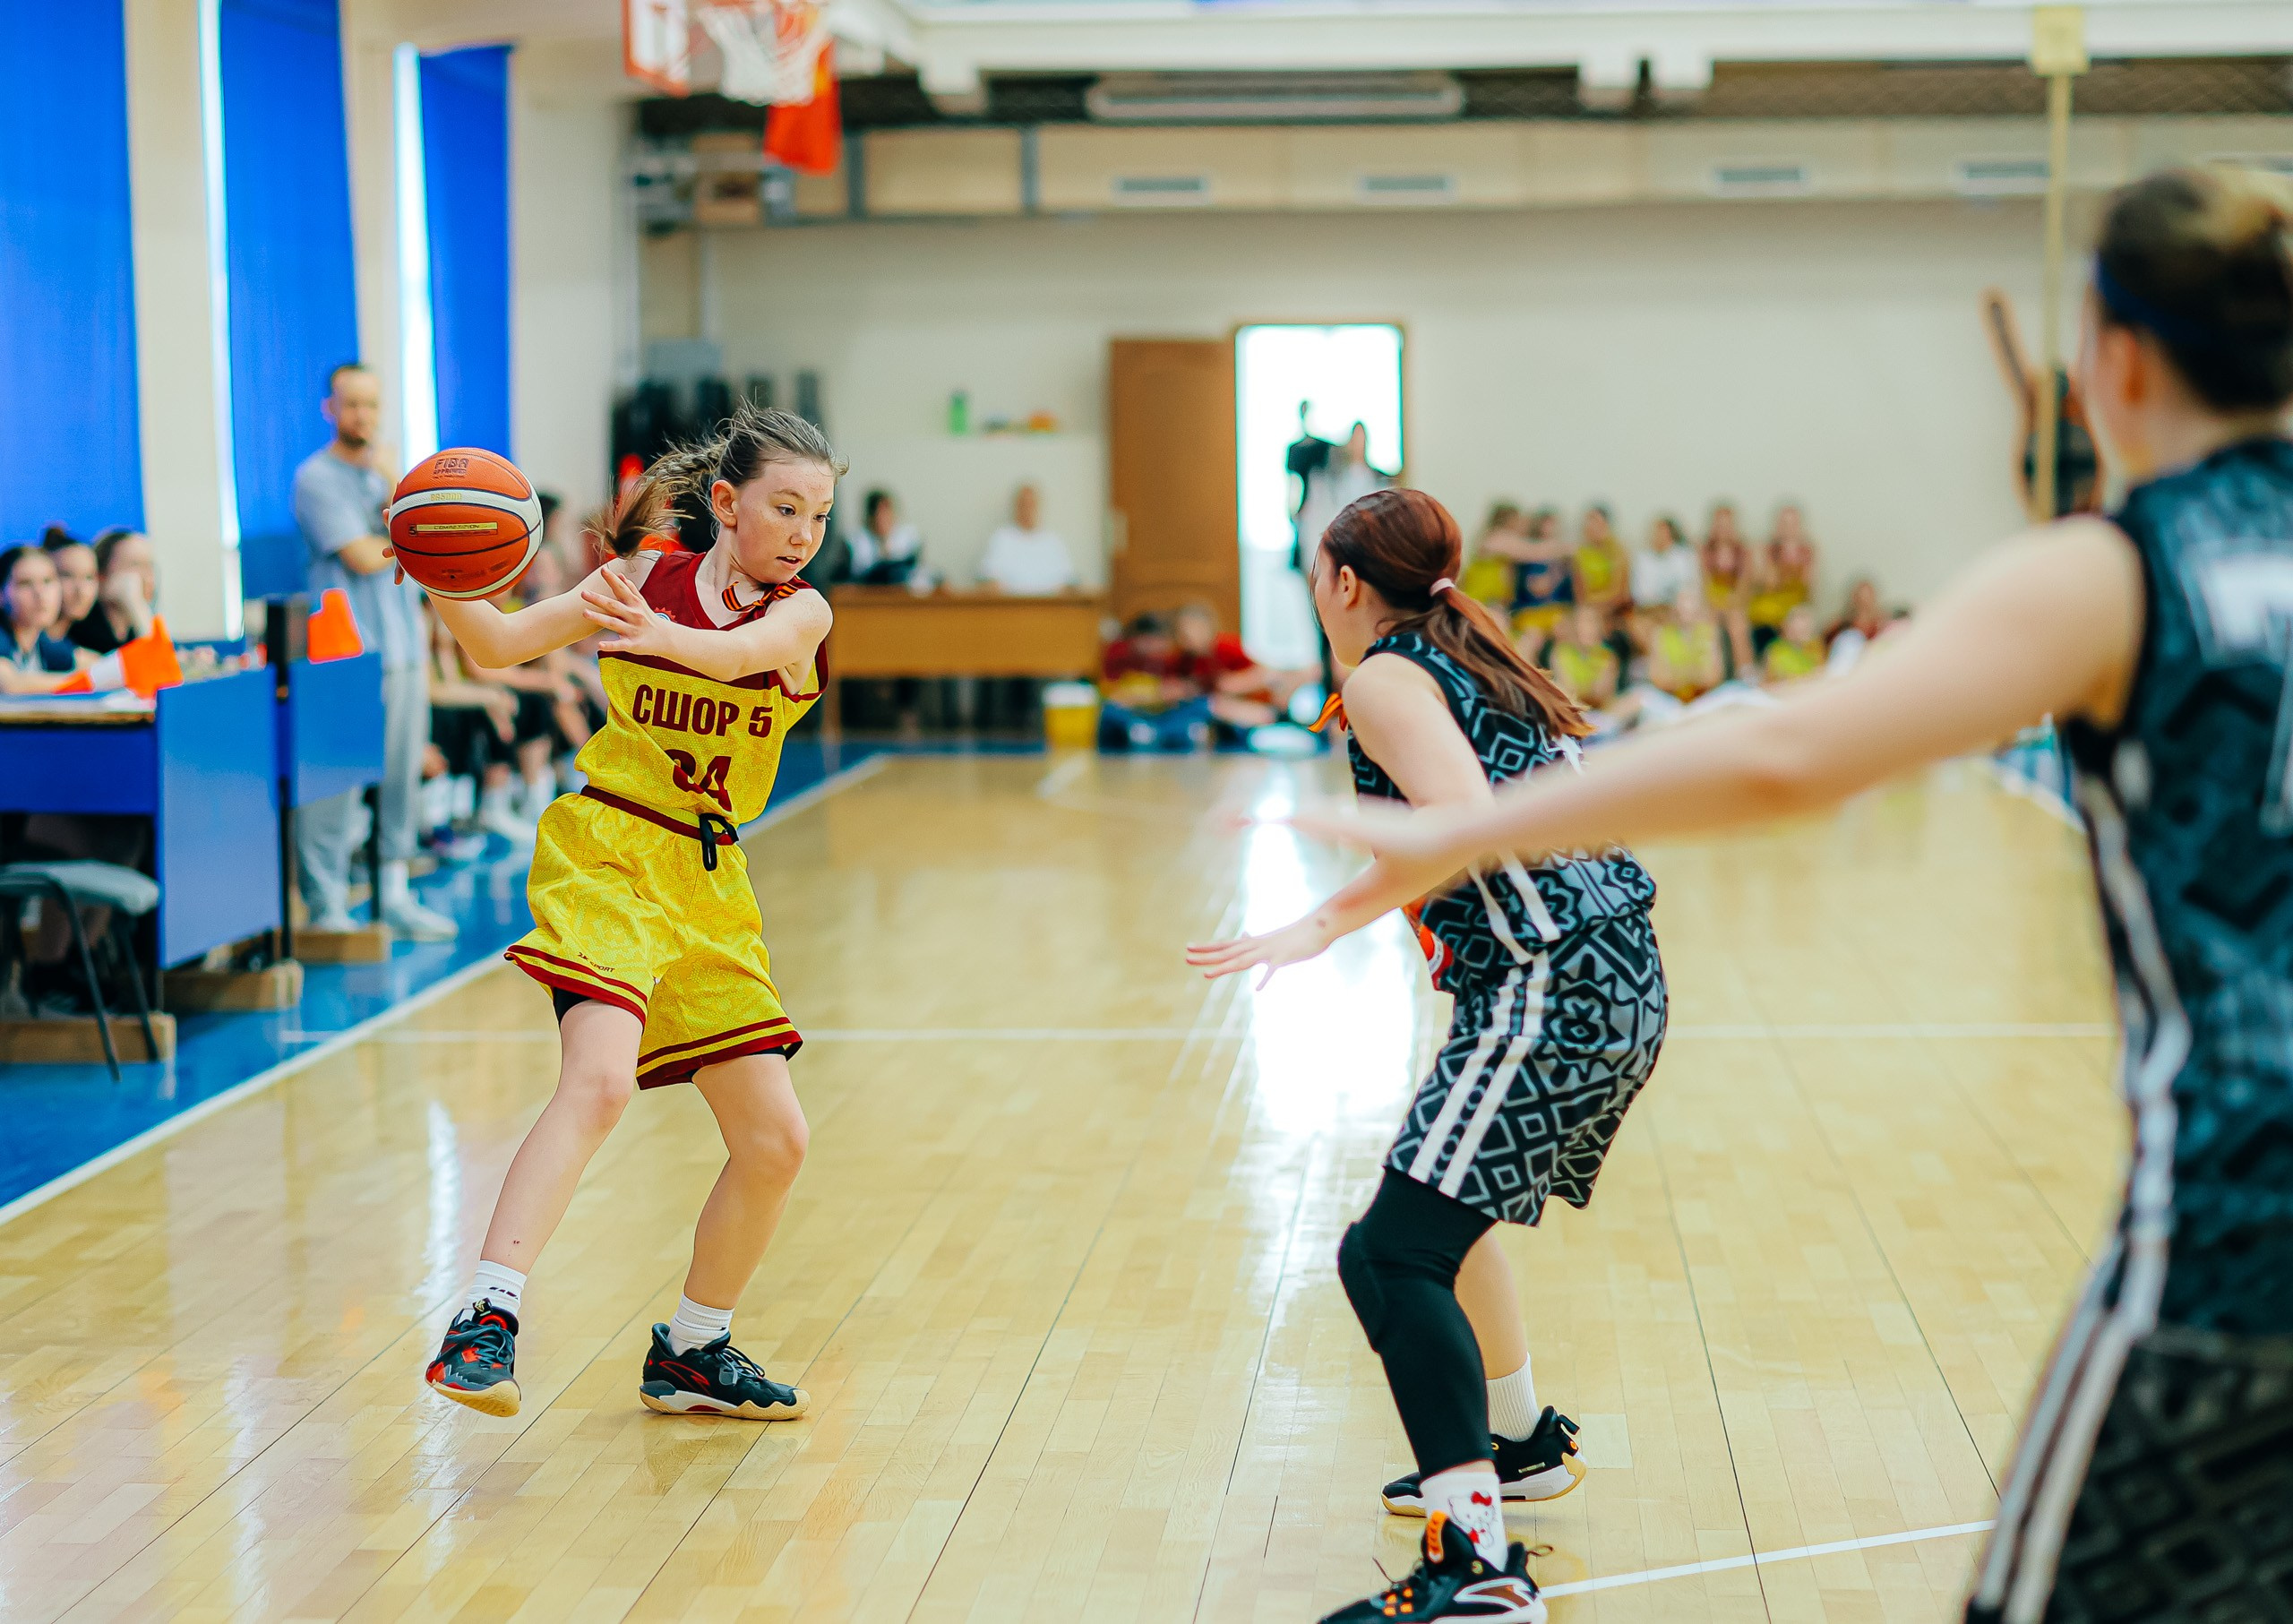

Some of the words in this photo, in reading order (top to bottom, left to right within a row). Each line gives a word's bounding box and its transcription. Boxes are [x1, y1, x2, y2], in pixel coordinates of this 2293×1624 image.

[434, 458, 469, 468] FIBA
[632, 683, 740, 737] СШОР
[748, 705, 774, 738] 5
